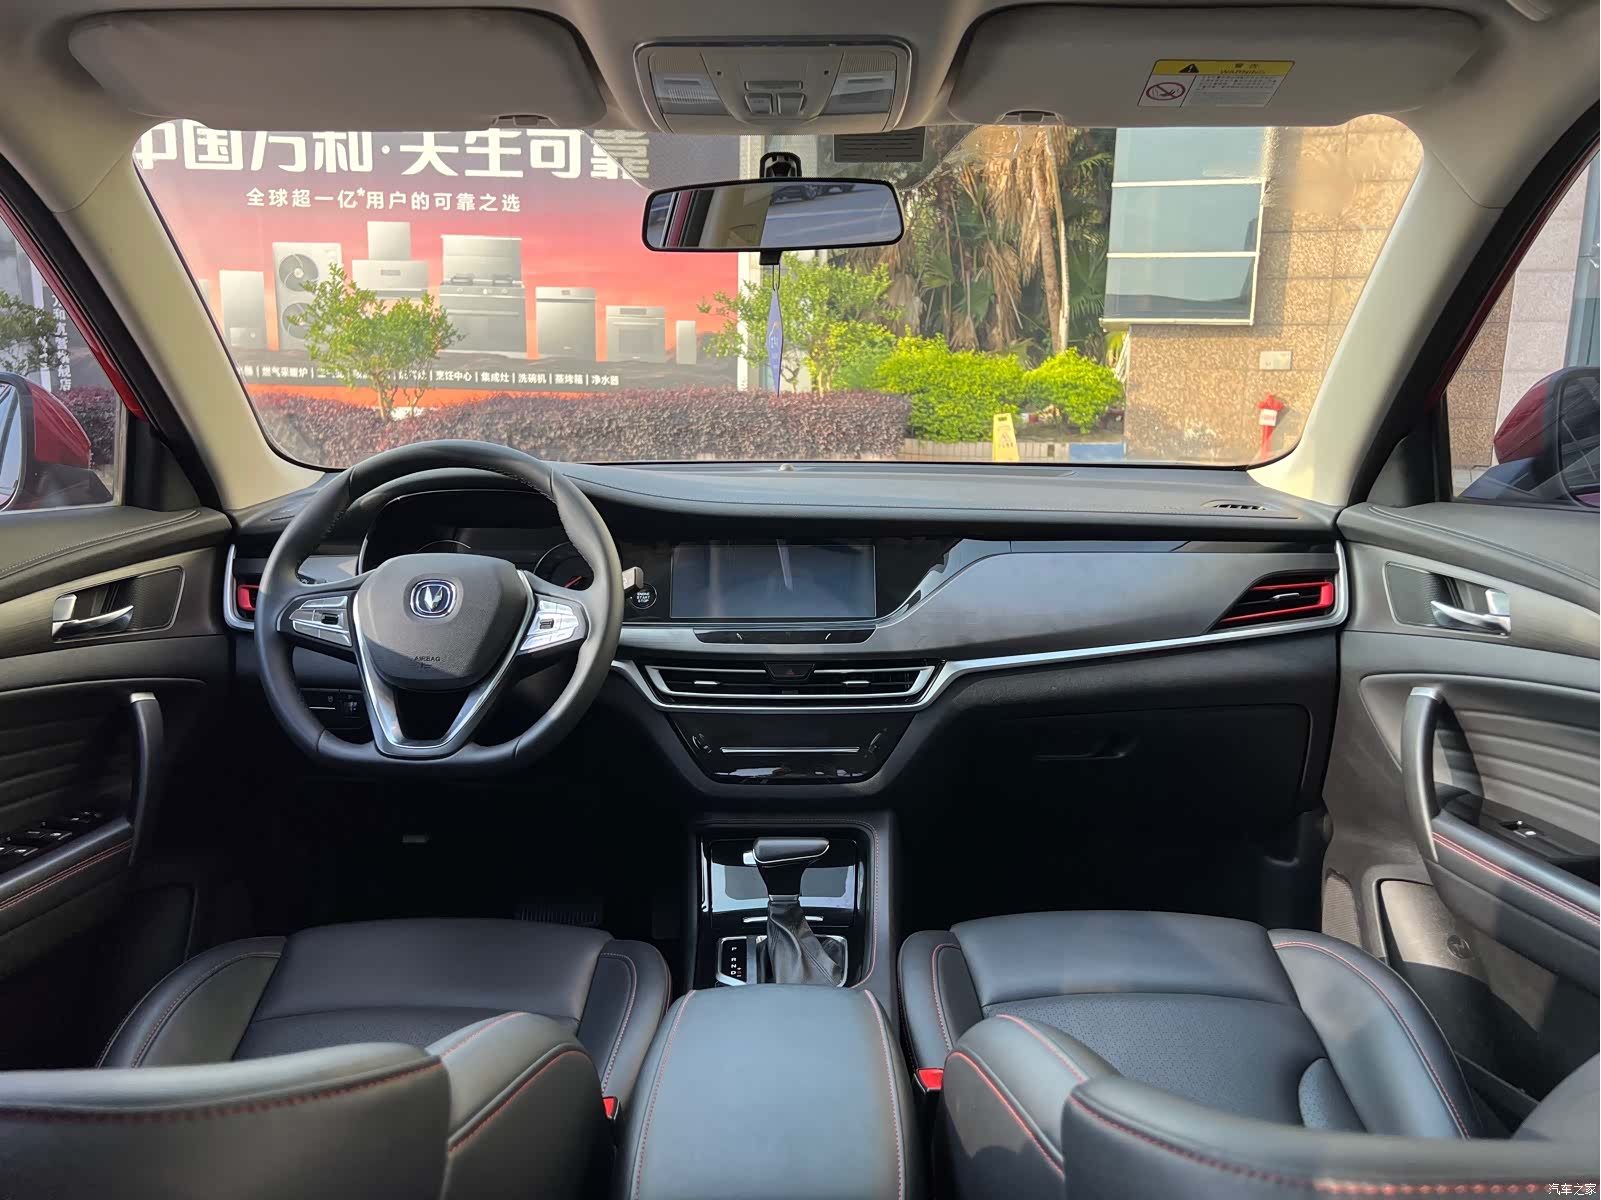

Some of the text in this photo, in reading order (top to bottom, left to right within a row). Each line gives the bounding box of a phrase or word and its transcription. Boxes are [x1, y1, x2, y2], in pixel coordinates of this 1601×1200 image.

[436, 370, 472, 382] 烹饪中心
[481, 371, 510, 383] 集成灶
[518, 373, 546, 384] 洗碗机
[555, 373, 583, 385] 蒸烤箱
[591, 375, 619, 386] 净水器
